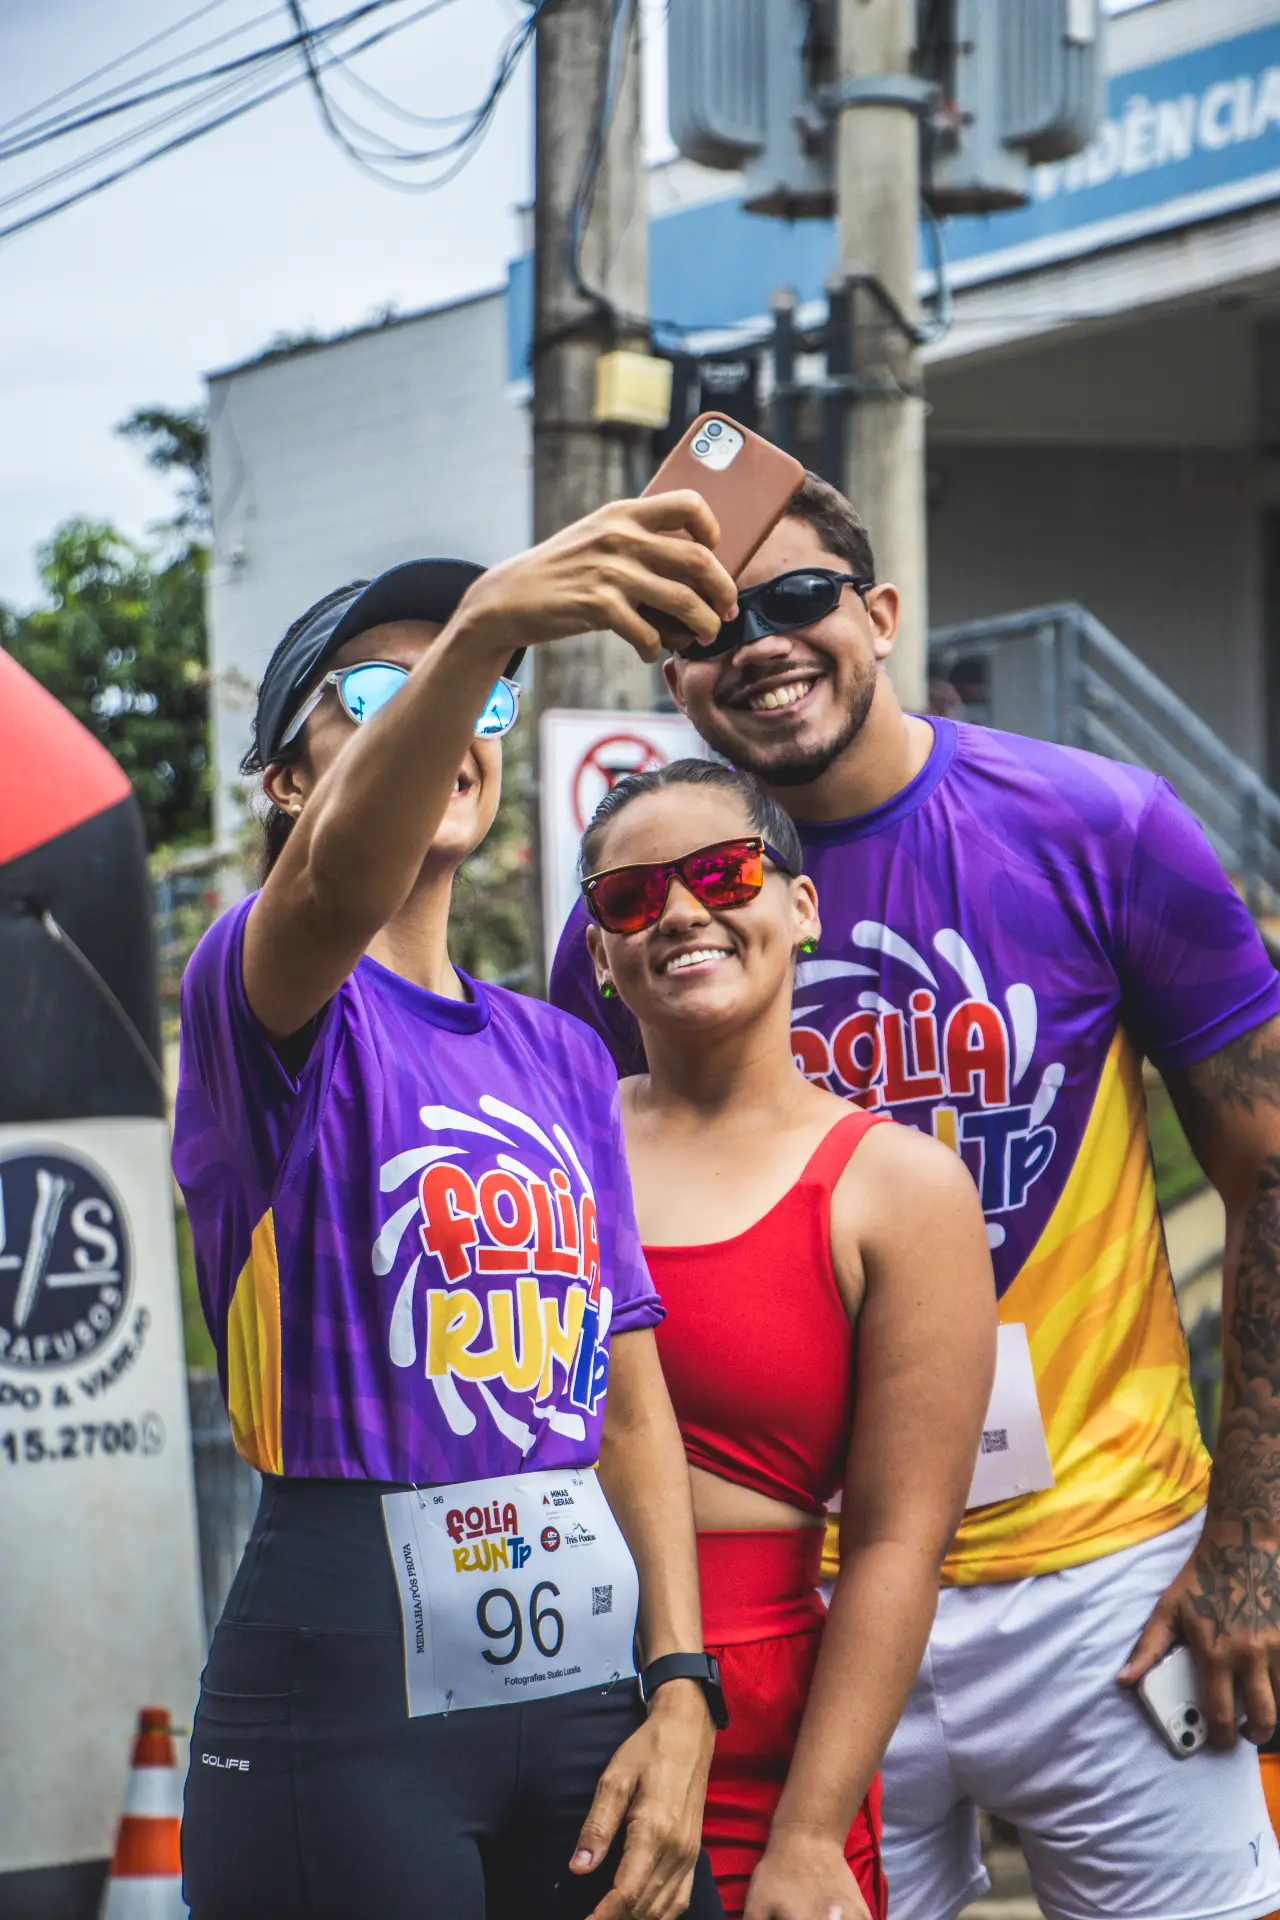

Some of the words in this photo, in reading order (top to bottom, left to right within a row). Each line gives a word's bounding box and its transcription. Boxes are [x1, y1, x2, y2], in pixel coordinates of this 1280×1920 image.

[432, 1495, 445, 1505] 96
[550, 1489, 569, 1498] MINAS
[553, 1497, 575, 1506] GERAIS
[402, 1543, 417, 1577] PROVA
[476, 1581, 565, 1666] 96
[504, 1673, 546, 1686] Fotografias
[547, 1669, 563, 1680] Studio
[202, 1753, 250, 1771] GOLIFE
